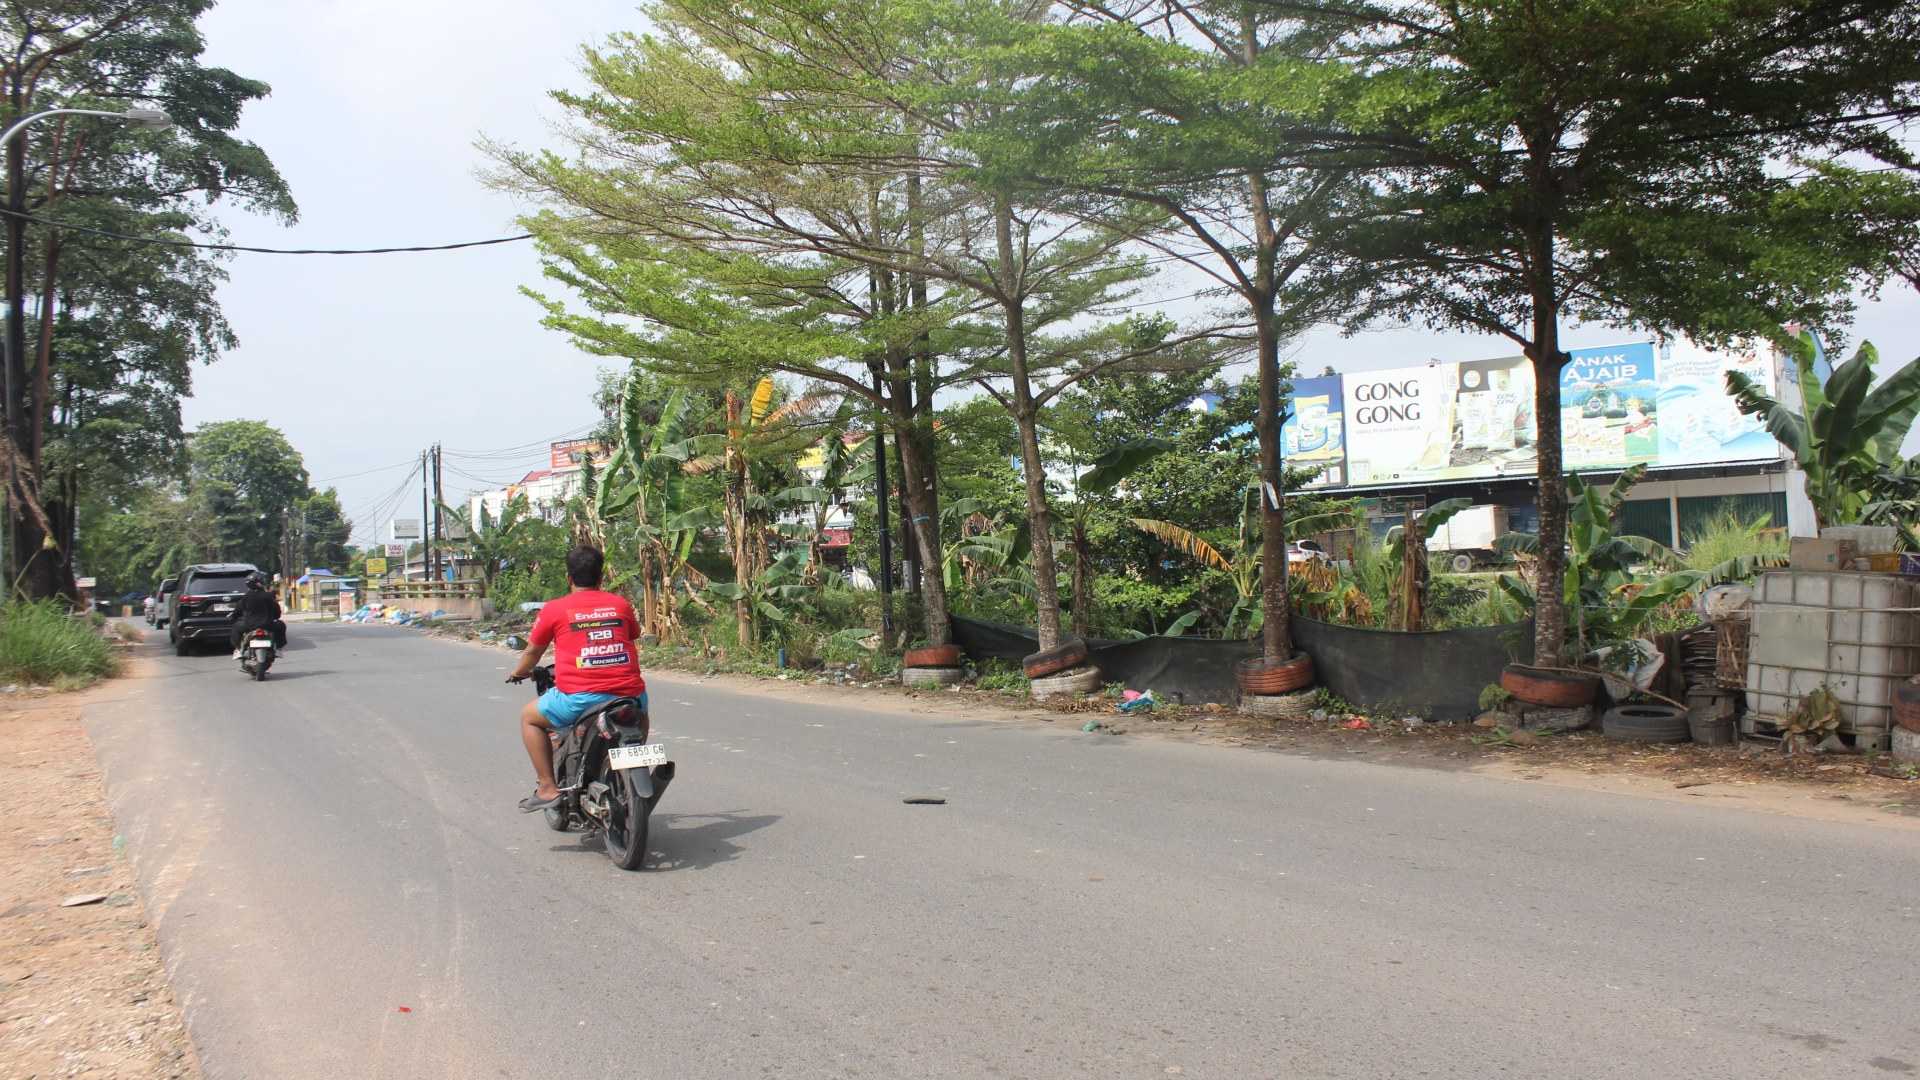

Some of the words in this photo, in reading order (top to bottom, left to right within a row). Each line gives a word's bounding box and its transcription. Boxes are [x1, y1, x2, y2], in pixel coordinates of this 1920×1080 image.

[1572, 353, 1627, 368] ANAK
[1562, 364, 1638, 382] AJAIB
[1355, 379, 1419, 401] GONG
[1356, 402, 1420, 424] GONG
[574, 611, 617, 620] Enduro
[580, 643, 624, 657] DUCATI
[592, 656, 625, 665] MICHELIN
[610, 749, 621, 759] BP
[628, 746, 649, 757] 6850
